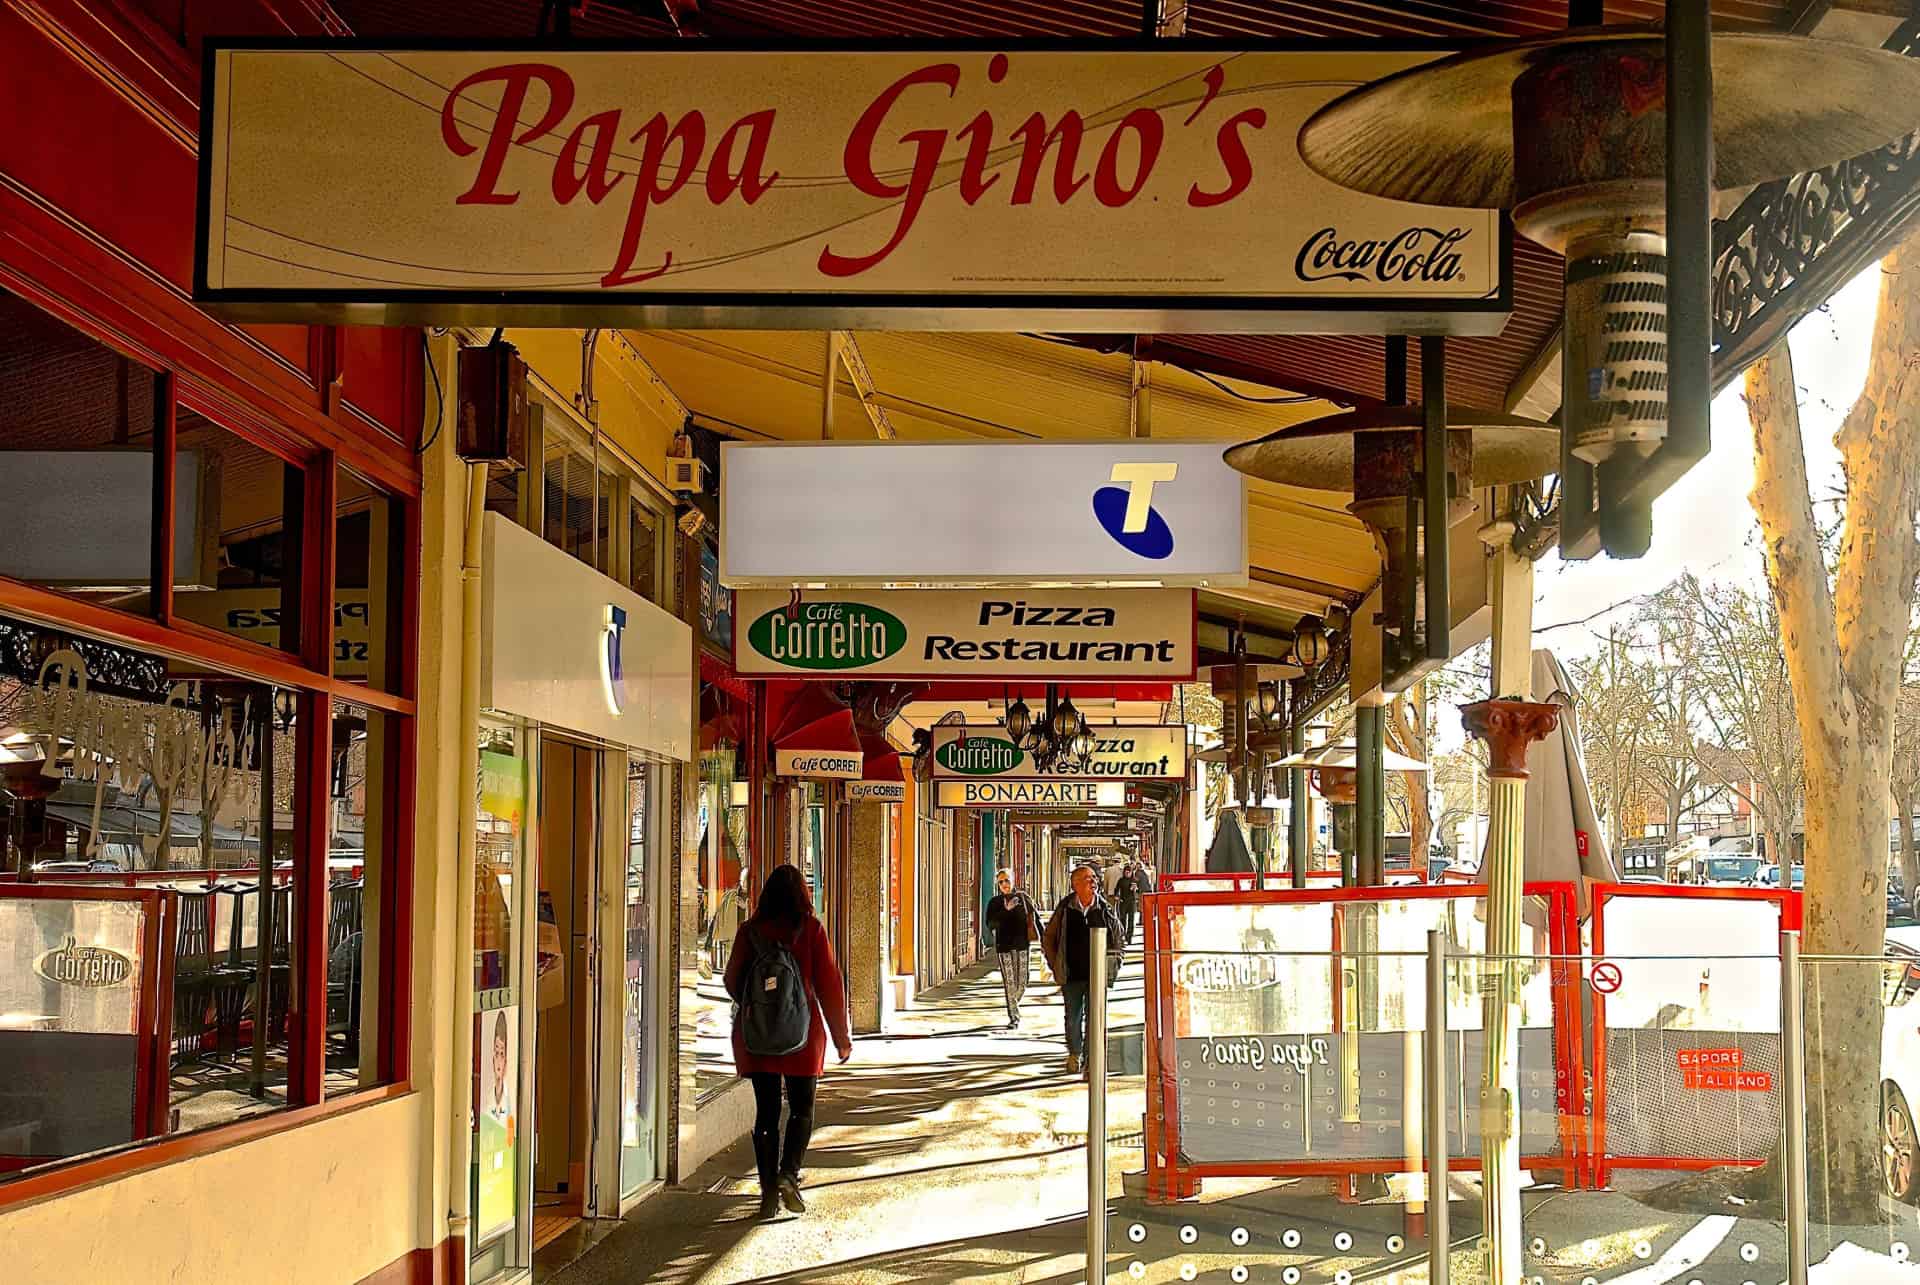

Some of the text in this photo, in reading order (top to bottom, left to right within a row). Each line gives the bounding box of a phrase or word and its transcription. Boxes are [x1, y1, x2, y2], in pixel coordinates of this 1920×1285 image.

[441, 53, 1267, 288] Papa Gino's
[1295, 227, 1473, 282] Coca-Cola
[806, 604, 843, 621] Café
[978, 600, 1116, 626] Pizza
[771, 613, 886, 659] Corretto
[923, 635, 1176, 662] Restaurant
[948, 743, 1013, 769] Corretto
[1095, 738, 1135, 753] zza
[965, 783, 1097, 801] BONAPARTE
[1680, 1052, 1740, 1065] SAPORE
[1688, 1074, 1767, 1087] ITALIANO
